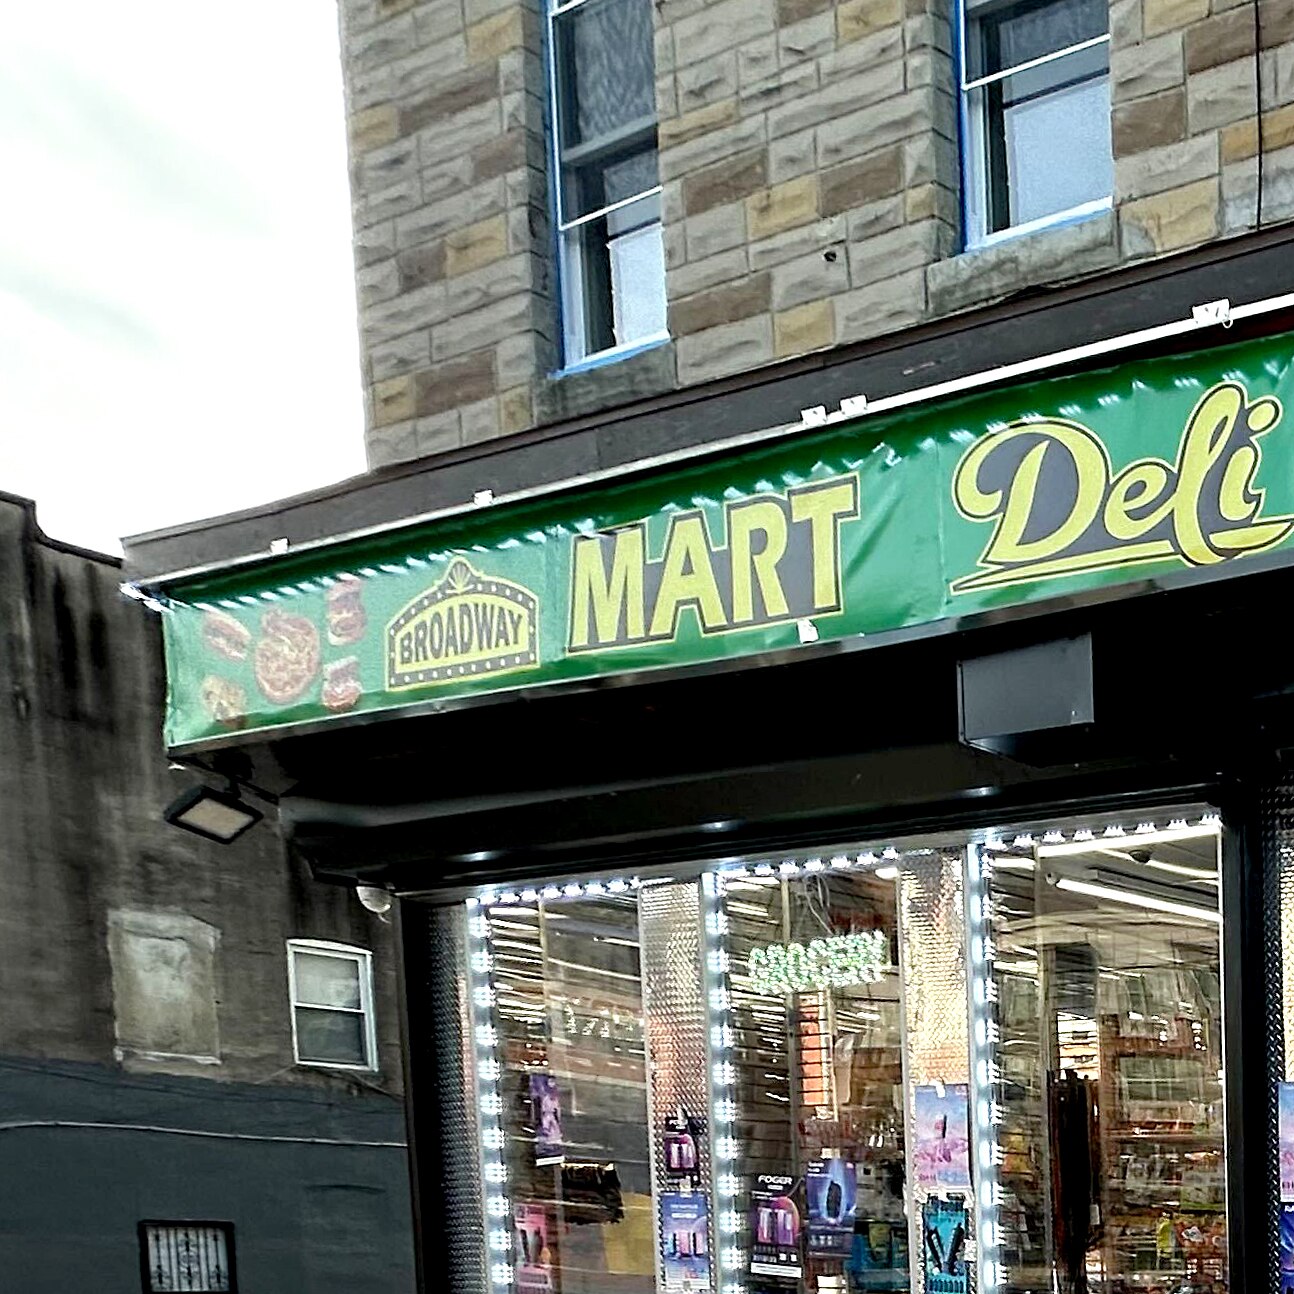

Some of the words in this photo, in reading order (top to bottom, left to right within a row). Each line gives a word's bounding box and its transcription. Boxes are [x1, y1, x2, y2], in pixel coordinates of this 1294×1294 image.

[399, 602, 524, 665] BROADWAY
[567, 473, 860, 655] MART
[758, 1175, 793, 1185] FOGER
